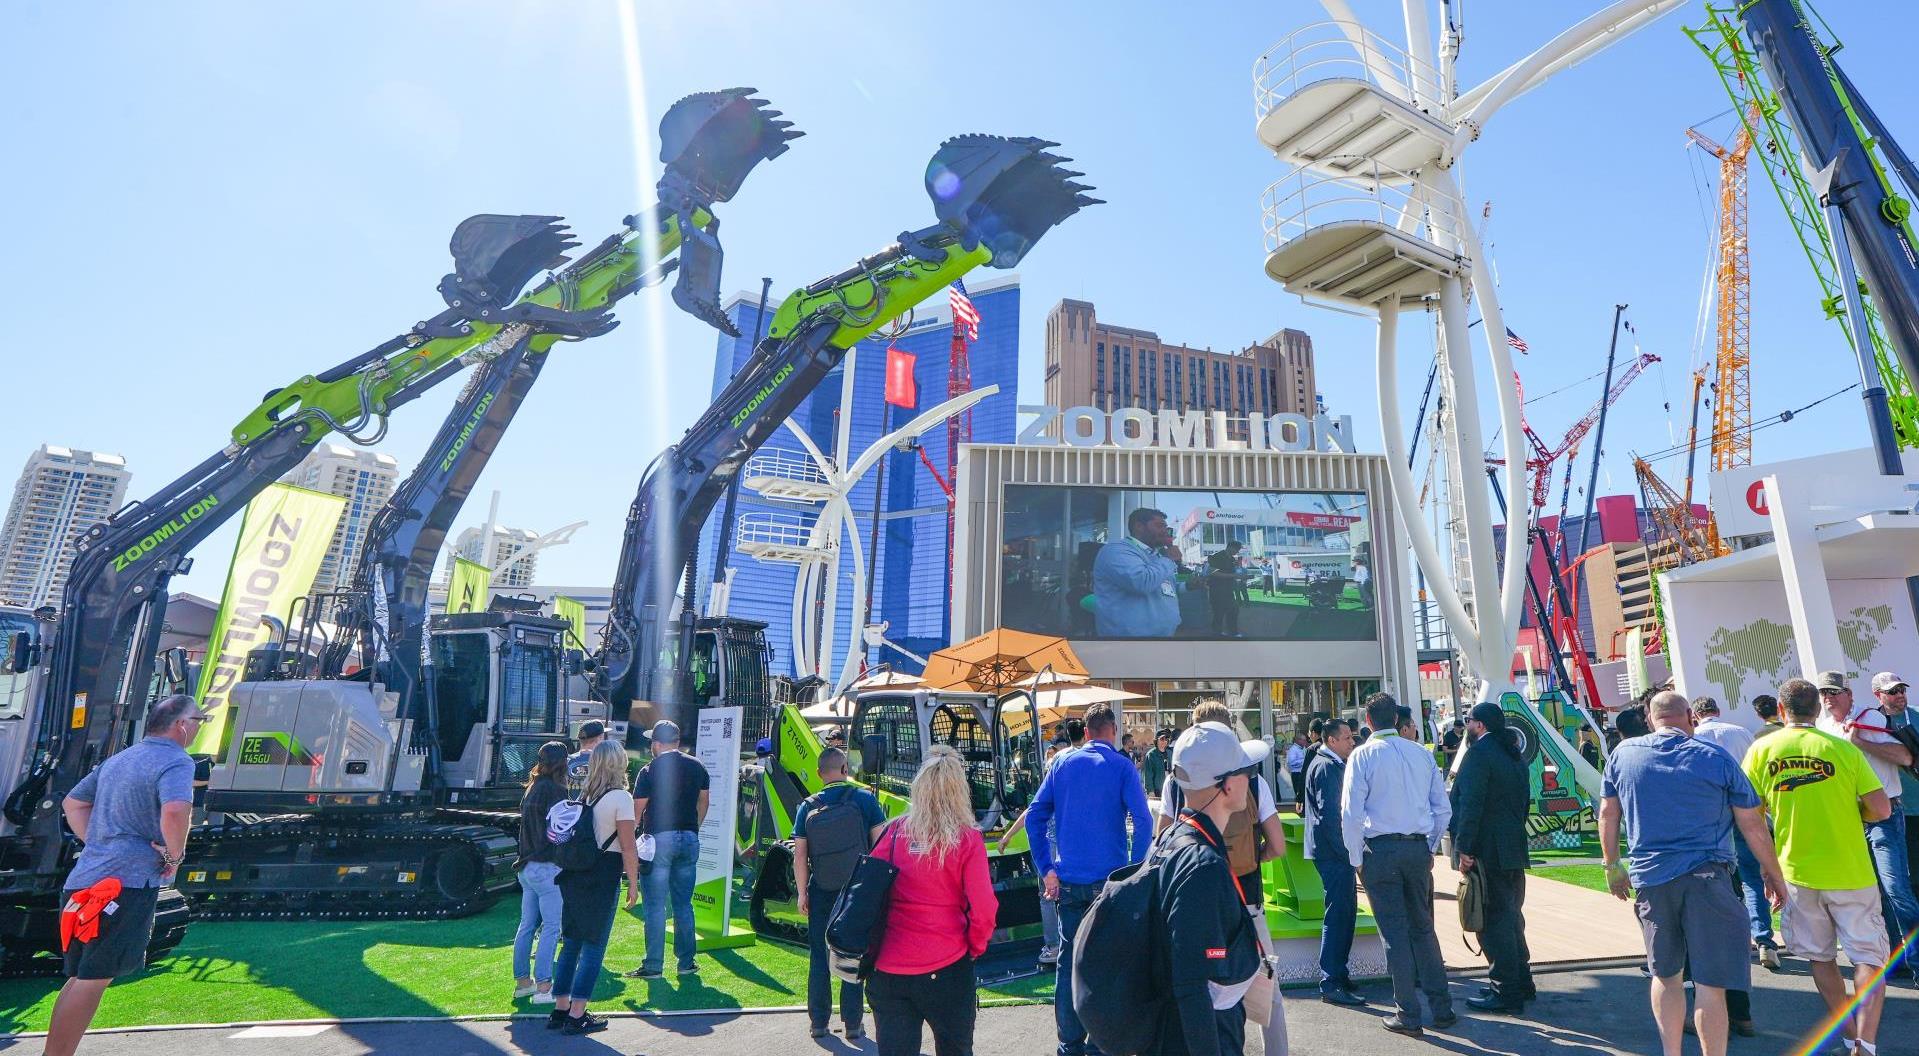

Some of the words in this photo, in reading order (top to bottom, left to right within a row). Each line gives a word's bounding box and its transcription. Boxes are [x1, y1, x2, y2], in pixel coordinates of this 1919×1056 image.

[730, 363, 794, 429] ZOOMLION
[440, 391, 494, 472] ZOOMLION
[1017, 405, 1354, 453] ZOOMLION
[111, 494, 219, 573] ZOOMLION
[199, 512, 303, 723] ZOOMLION
[244, 753, 271, 764] 145GU
[245, 738, 262, 753] ZE
[787, 726, 808, 760] ZT120V
